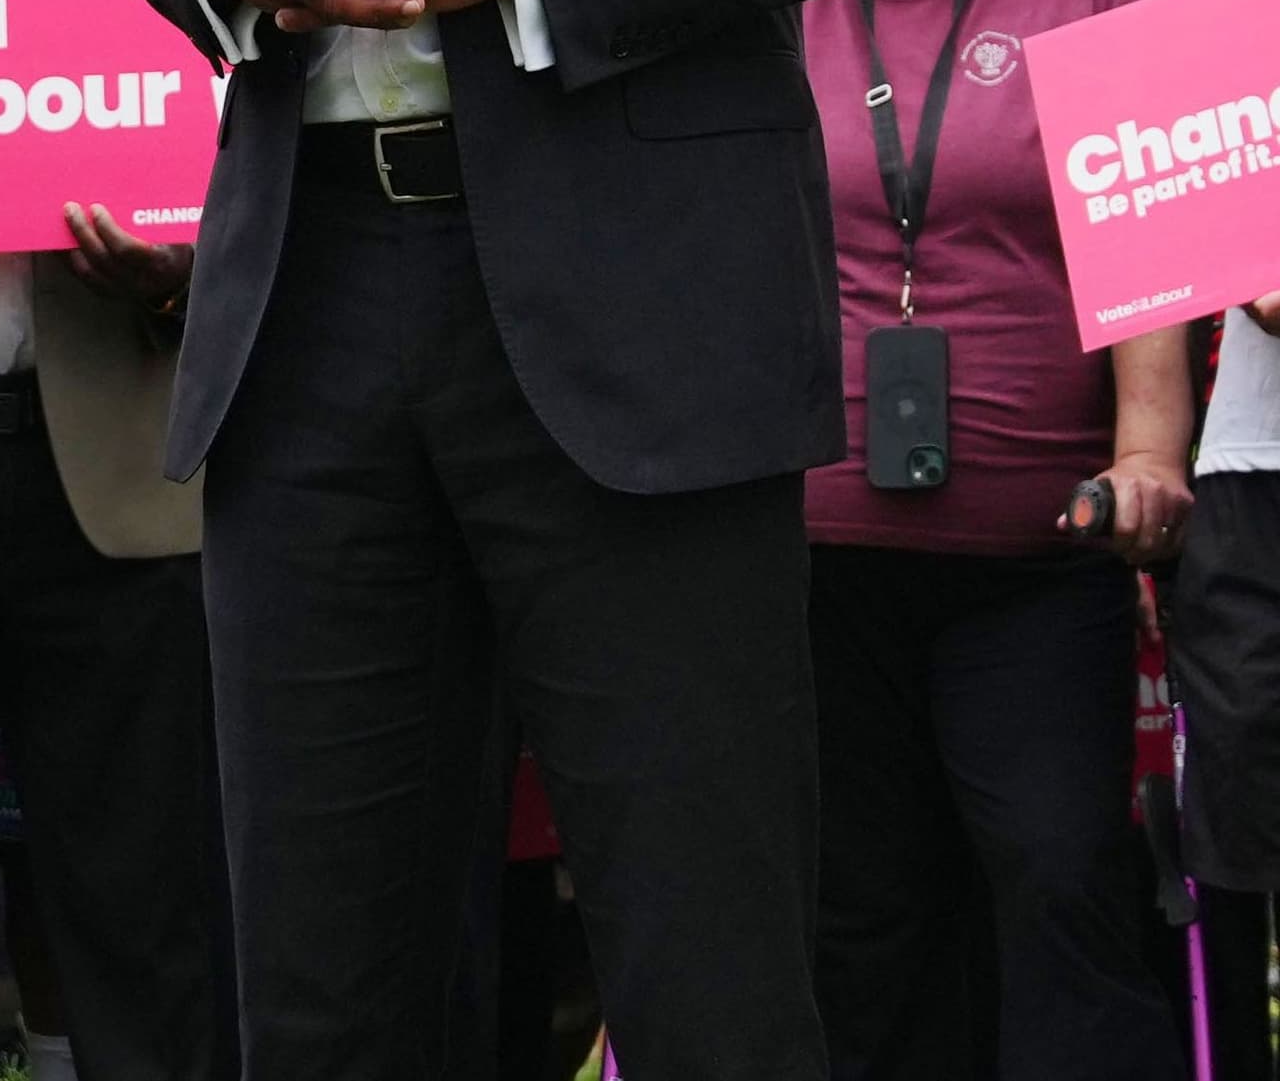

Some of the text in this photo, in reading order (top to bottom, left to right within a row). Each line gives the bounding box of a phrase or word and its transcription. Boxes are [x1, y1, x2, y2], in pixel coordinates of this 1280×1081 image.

[1066, 86, 1280, 194] Chan
[1086, 193, 1130, 224] Be
[1132, 164, 1207, 218] part
[1208, 149, 1242, 184] of
[132, 206, 204, 226] CHANG
[1095, 283, 1193, 324] Vote Labour
